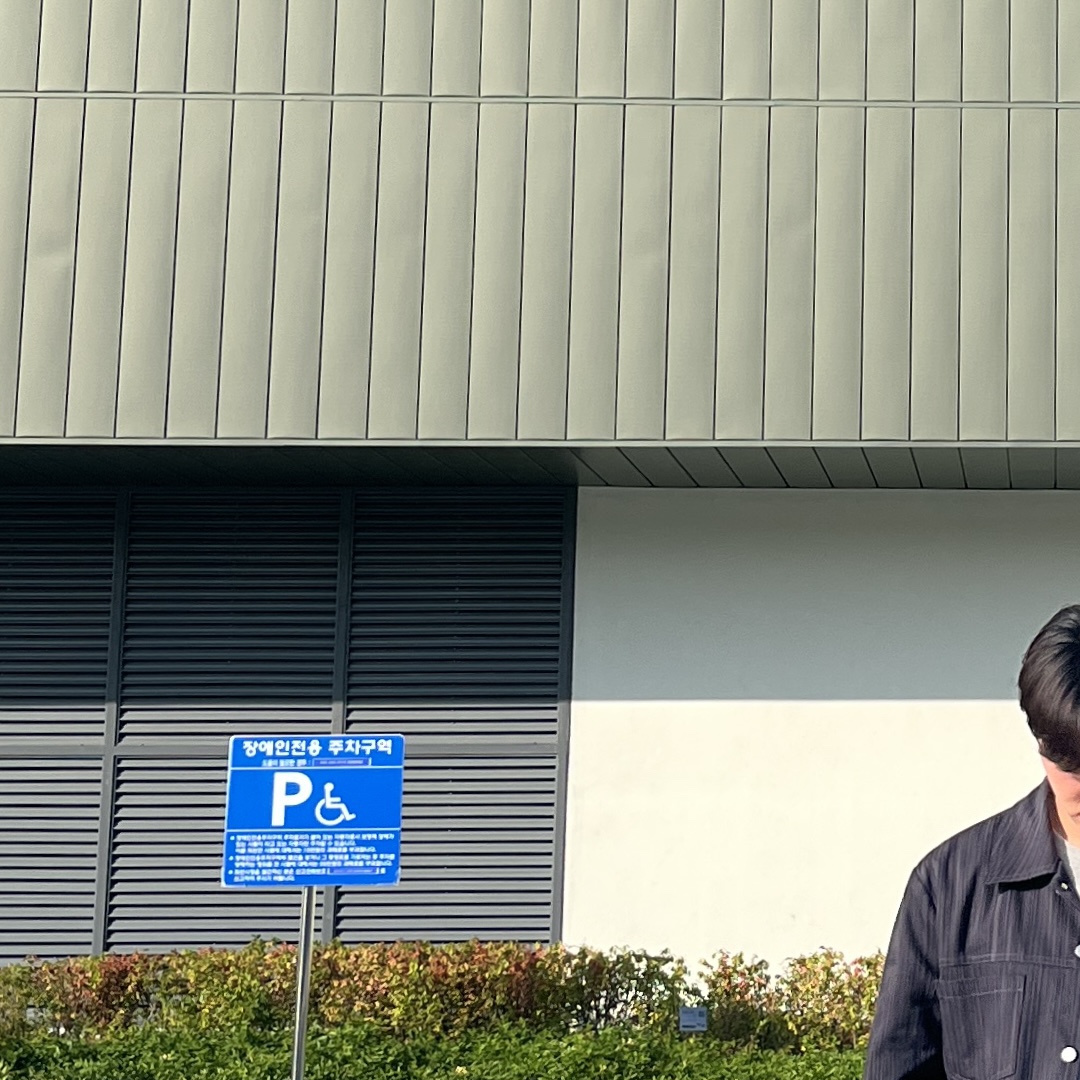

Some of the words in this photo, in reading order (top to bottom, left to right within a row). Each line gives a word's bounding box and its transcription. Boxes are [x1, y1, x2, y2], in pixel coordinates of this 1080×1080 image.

[243, 739, 322, 757] 장애인전용
[328, 739, 393, 756] 주차구역
[271, 772, 313, 827] P
